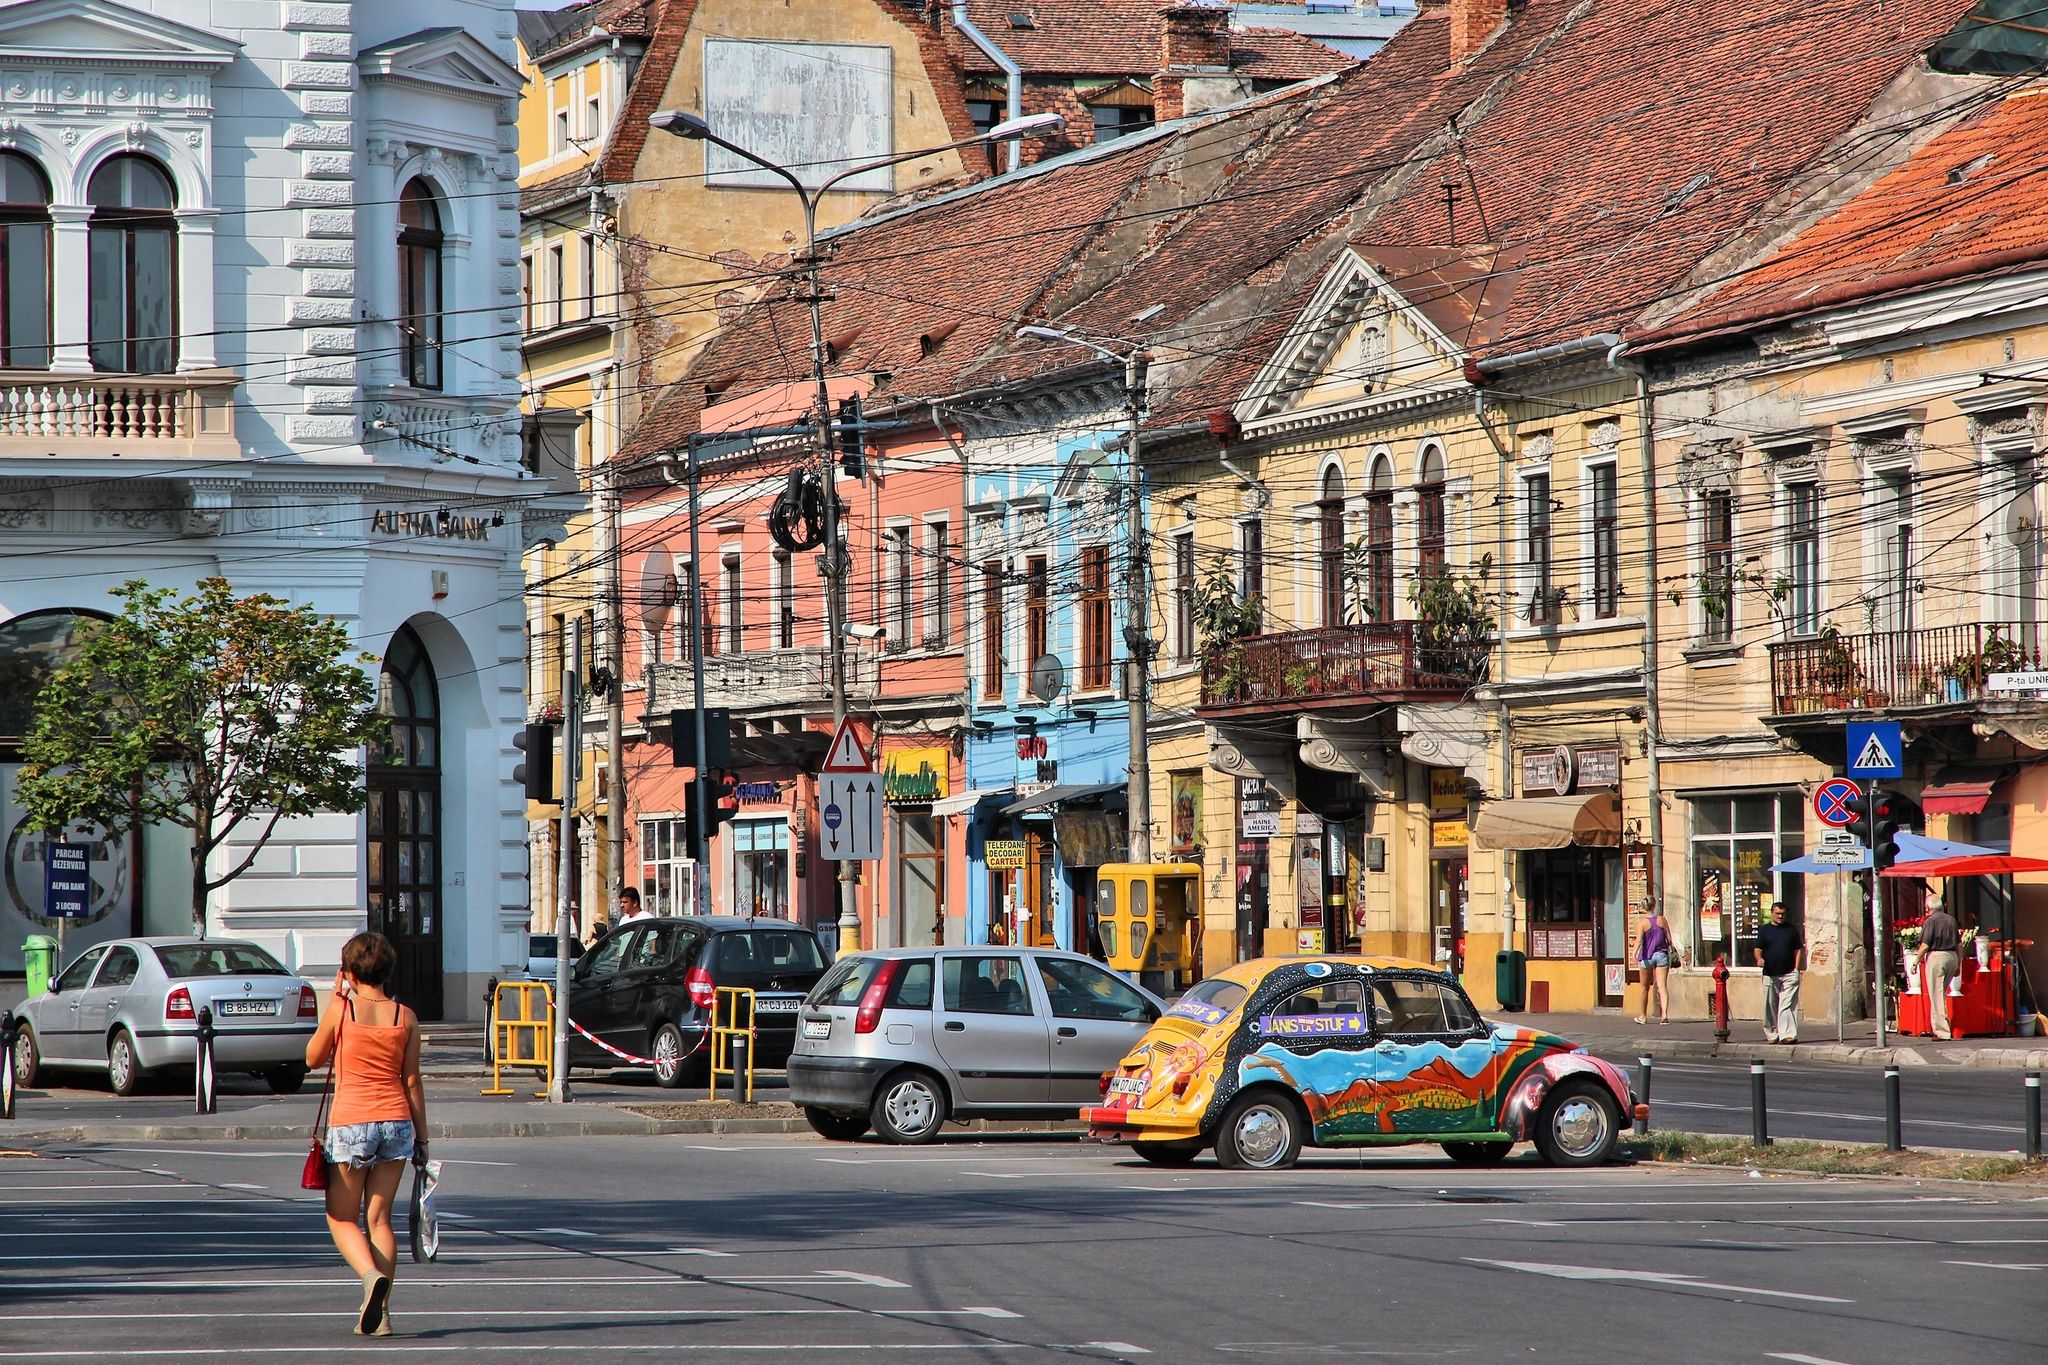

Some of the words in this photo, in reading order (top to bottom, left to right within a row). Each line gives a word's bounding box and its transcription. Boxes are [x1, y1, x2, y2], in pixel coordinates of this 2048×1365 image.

[371, 509, 435, 537] ALPHA
[988, 841, 1025, 849] TELEFOANE
[56, 849, 83, 858] PARCARE
[989, 849, 1024, 857] DECODARI
[53, 860, 86, 870] REZERVATA
[52, 882, 70, 890] ALPHA
[71, 883, 85, 891] BANK
[61, 902, 81, 911] LOCURI
[226, 1002, 233, 1012] B
[236, 1002, 248, 1012] 85
[249, 1002, 270, 1012] HZY
[758, 1001, 764, 1010] R
[782, 1001, 798, 1010] 120
[1265, 1018, 1299, 1034] JANIS
[1301, 1024, 1313, 1033] LA
[1315, 1017, 1345, 1032] STUF
